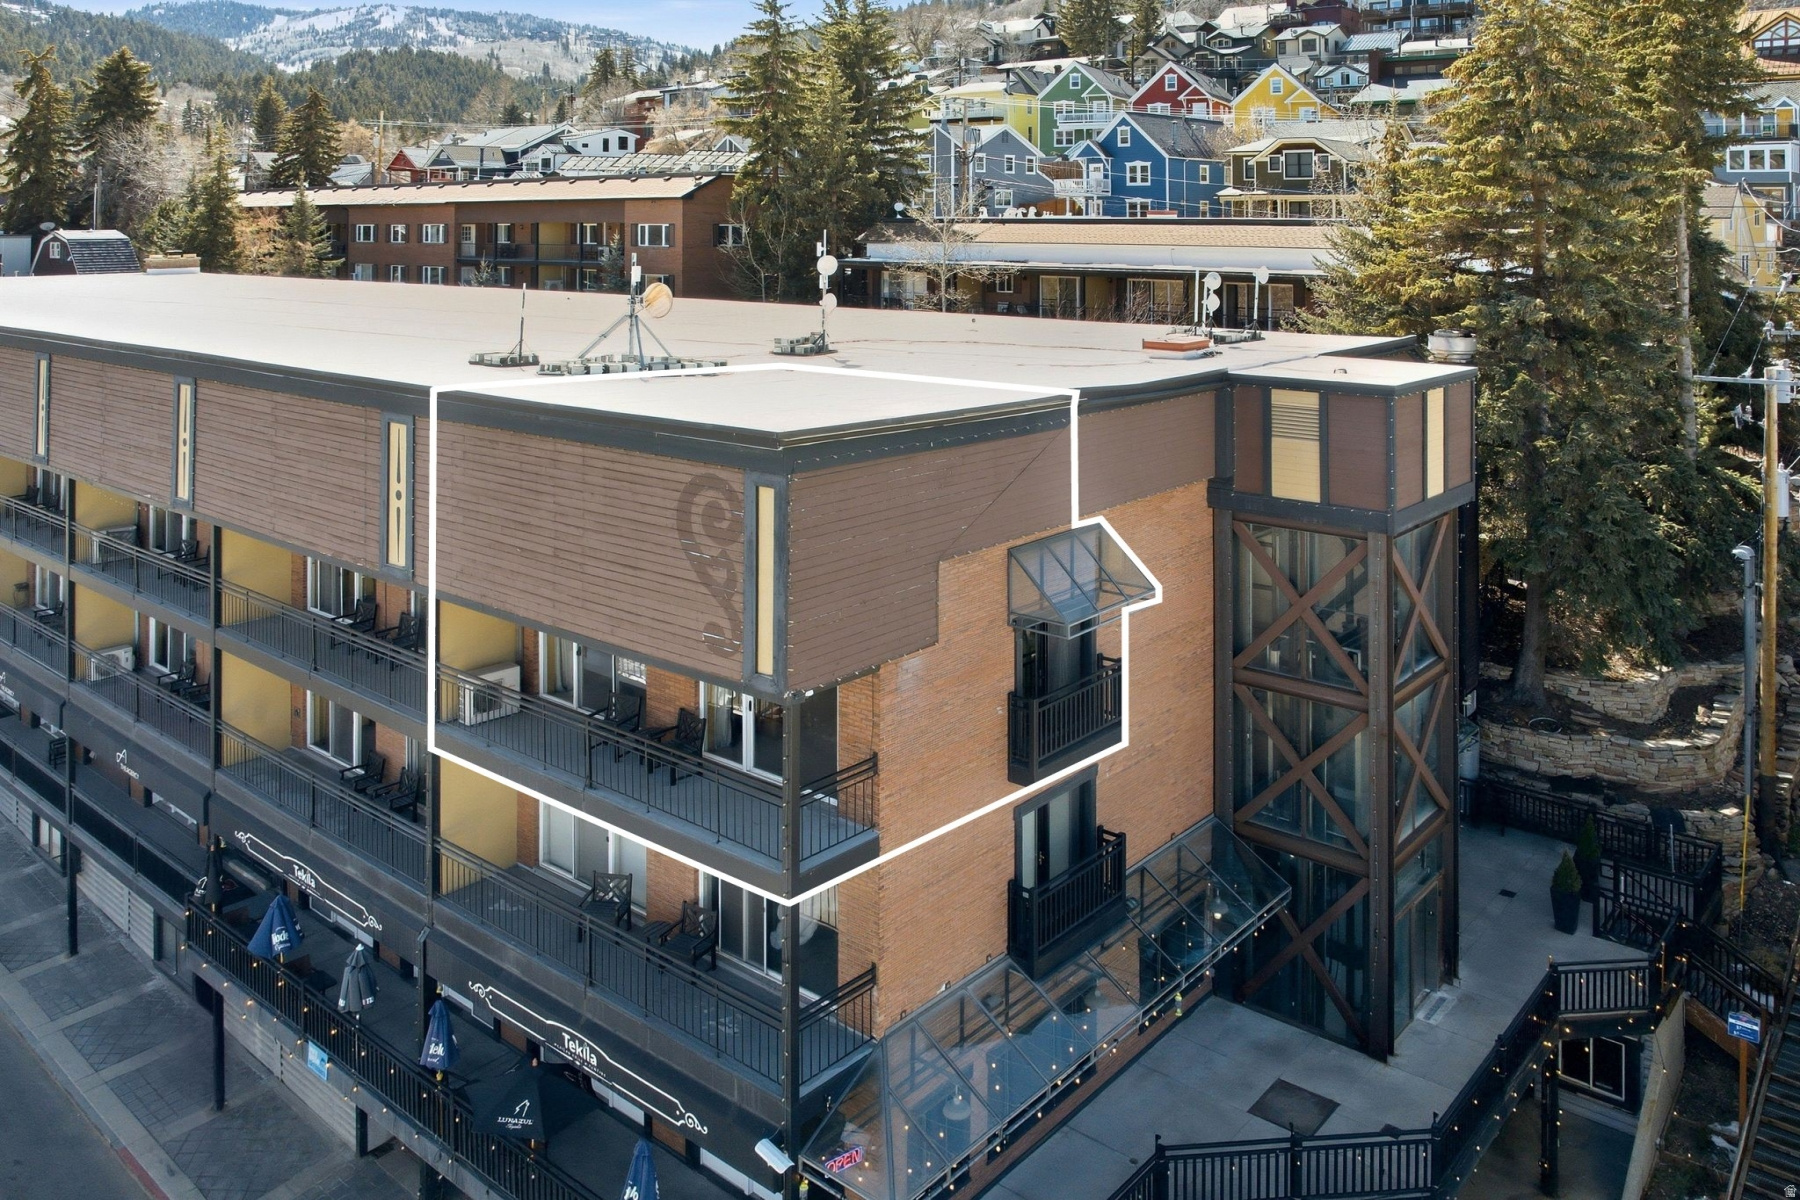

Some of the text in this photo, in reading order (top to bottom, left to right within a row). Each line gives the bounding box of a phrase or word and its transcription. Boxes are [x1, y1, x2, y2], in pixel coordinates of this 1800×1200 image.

[293, 864, 316, 888] Tekila
[562, 1032, 597, 1066] Tekila
[497, 1116, 534, 1125] LUNAZUL
[827, 1149, 860, 1172] OPEN
